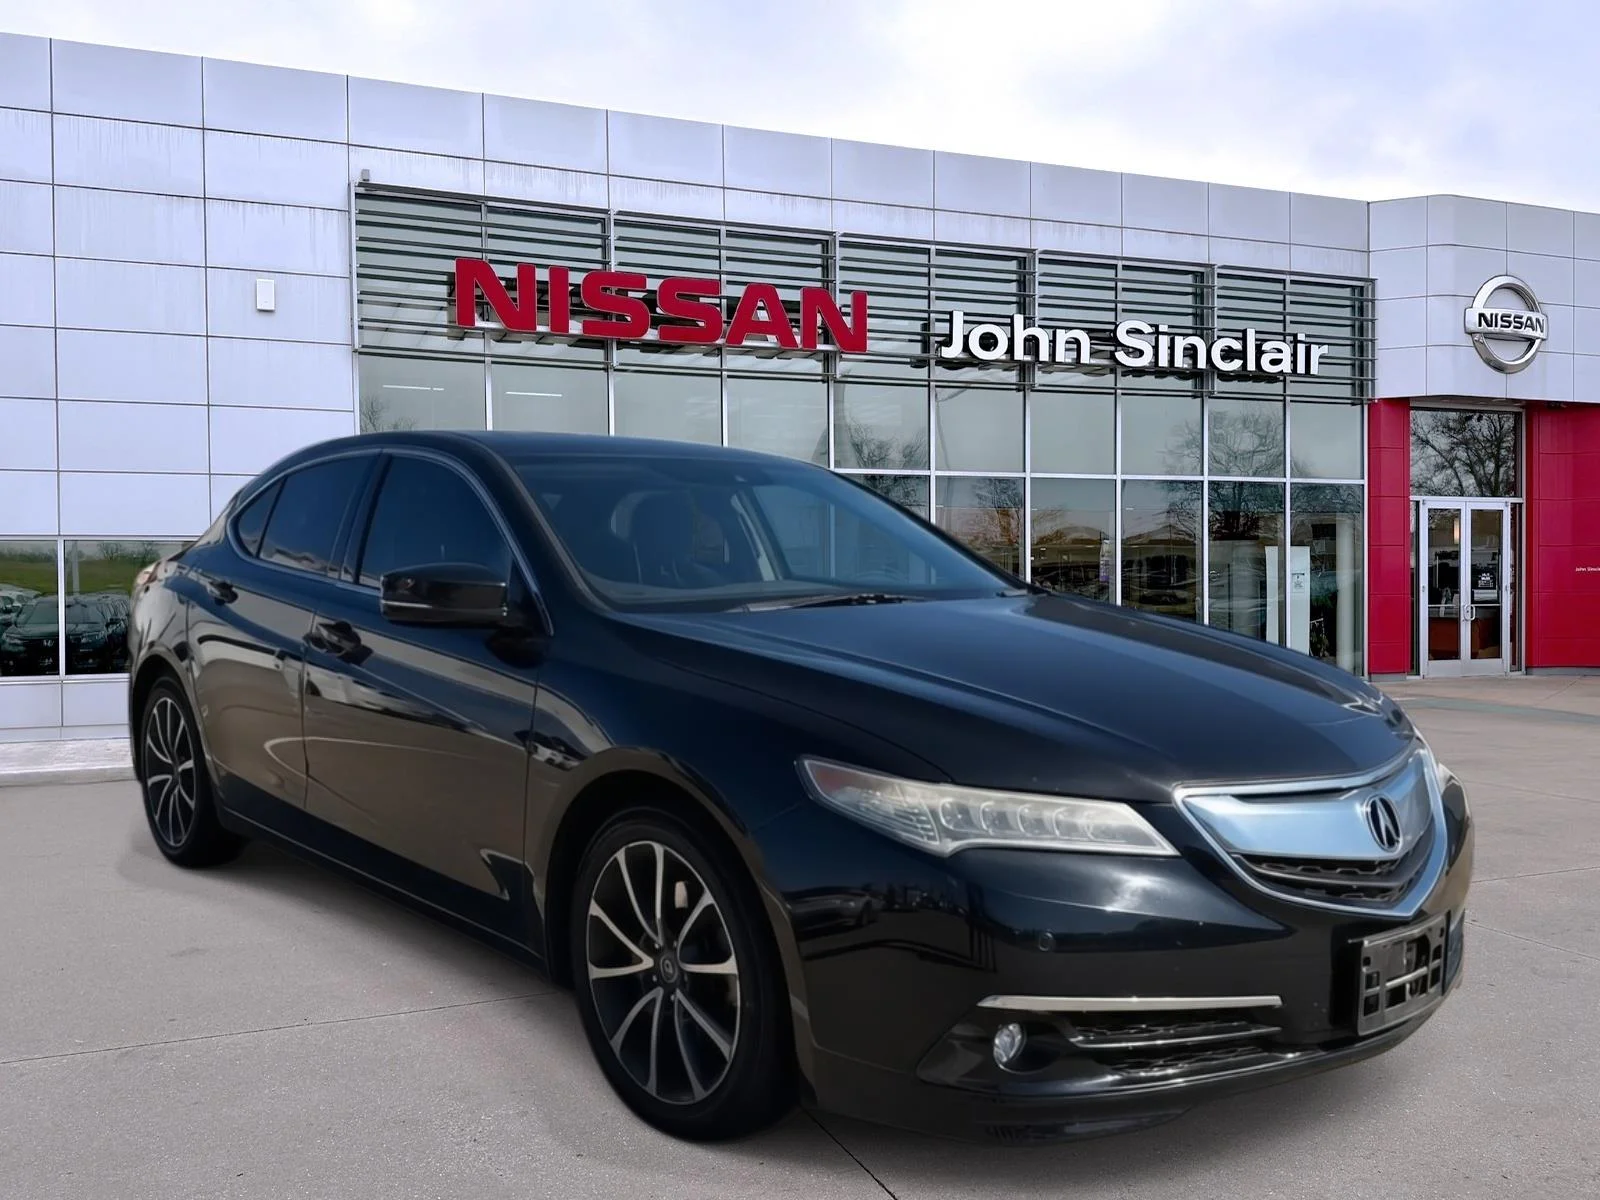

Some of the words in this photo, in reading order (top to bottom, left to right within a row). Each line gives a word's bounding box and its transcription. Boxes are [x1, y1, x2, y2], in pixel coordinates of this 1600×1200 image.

[455, 257, 868, 353] NISSAN
[1478, 312, 1545, 333] NISSAN
[940, 310, 1091, 364] John
[1114, 319, 1329, 375] Sinclair
